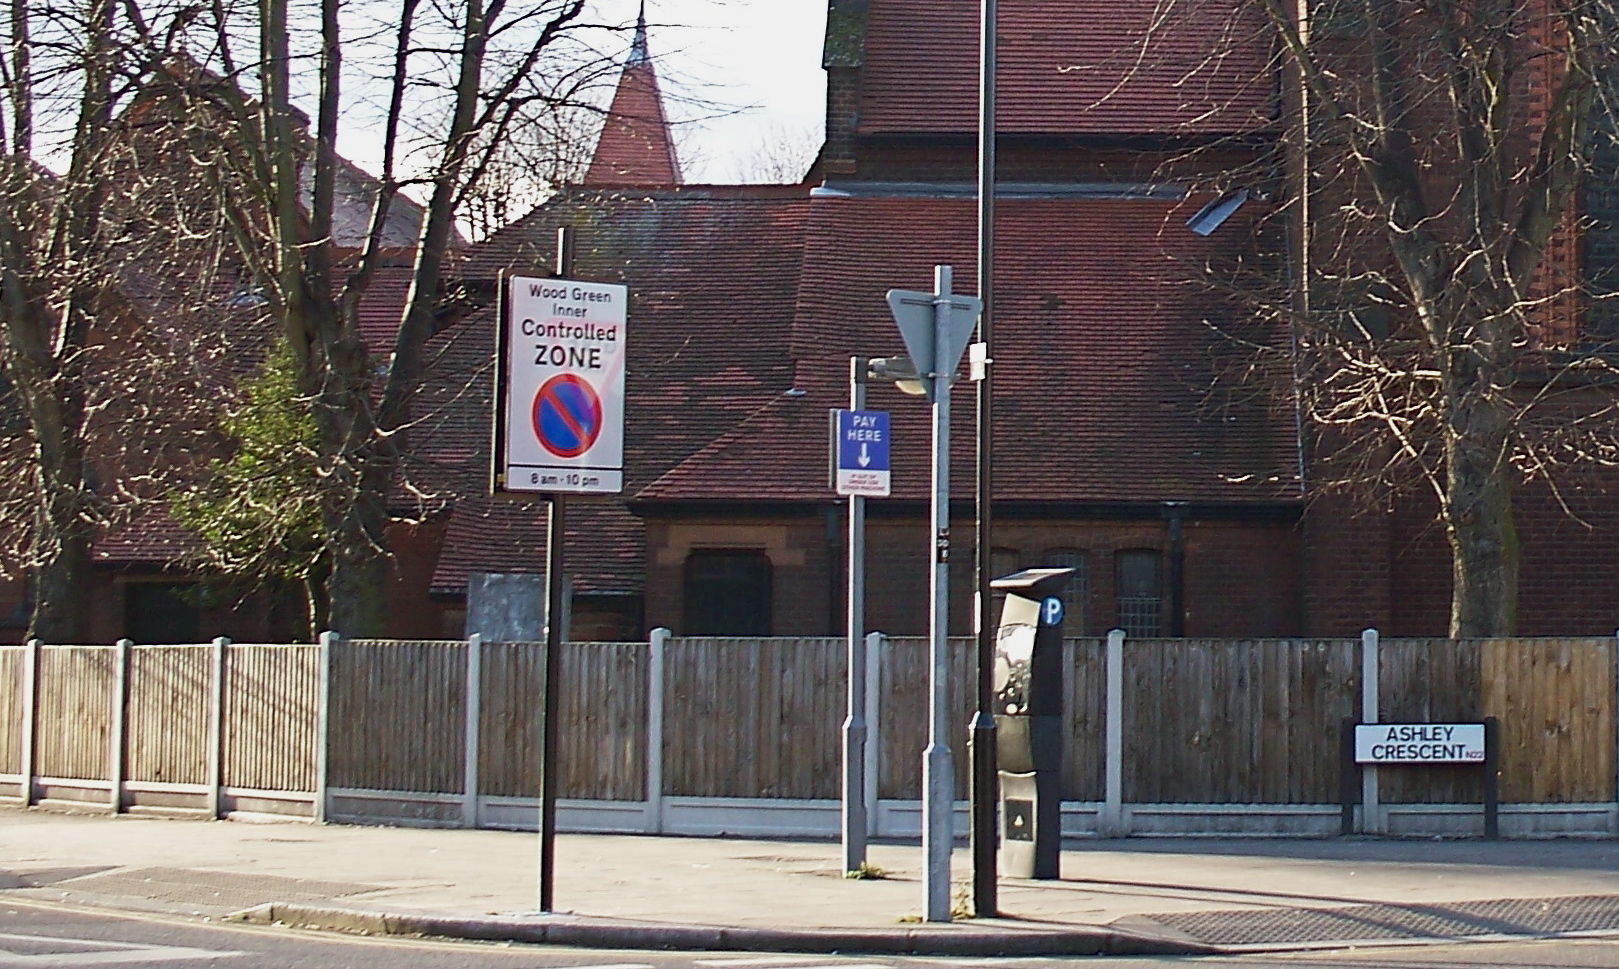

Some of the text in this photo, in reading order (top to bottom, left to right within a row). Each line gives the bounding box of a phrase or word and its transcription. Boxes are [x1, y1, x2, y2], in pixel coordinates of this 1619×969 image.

[529, 283, 611, 303] Wood Green
[553, 303, 587, 318] Inner
[521, 319, 616, 341] Controlled
[534, 345, 601, 369] ZONE
[853, 415, 877, 427] PAY
[847, 429, 881, 442] HERE
[531, 472, 539, 484] 8
[566, 474, 580, 485] 10
[582, 476, 599, 487] pm
[1046, 598, 1061, 624] P
[1386, 726, 1454, 742] ASHLEY
[1371, 744, 1466, 759] CRESCENT
